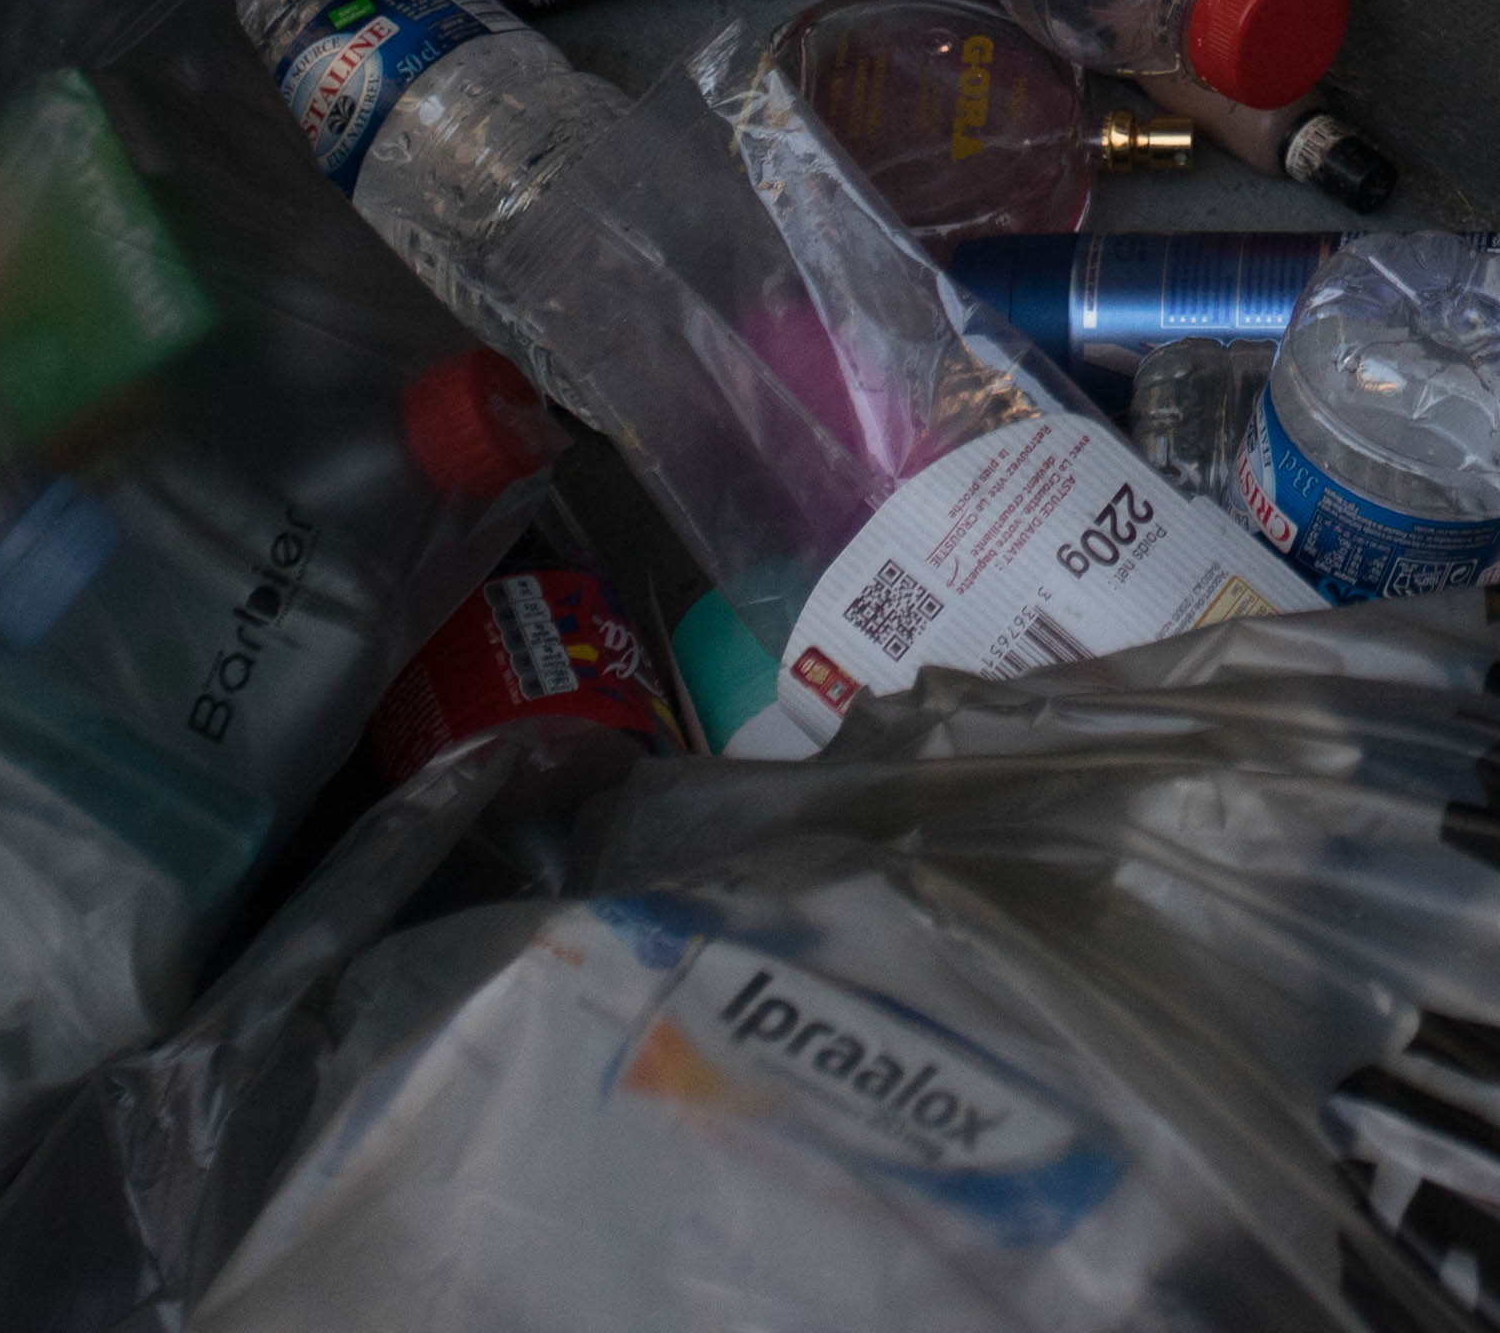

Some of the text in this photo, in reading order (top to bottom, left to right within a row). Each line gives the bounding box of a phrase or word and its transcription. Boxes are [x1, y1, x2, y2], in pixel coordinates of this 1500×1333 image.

[301, 22, 392, 139] STALINE
[1007, 425, 1052, 476] Retrouvez
[1070, 435, 1090, 459] avec
[949, 482, 980, 519] proche
[971, 454, 1056, 557] devient croustillante
[988, 477, 1007, 497] vite
[1040, 474, 1076, 518] ASTUCE
[1237, 455, 1290, 542] CRIST
[931, 513, 978, 569] CROUSTIE
[996, 517, 1023, 548] votre
[1056, 482, 1154, 579] 220g
[1130, 523, 1168, 563] Poids
[956, 549, 998, 595] baguette
[1036, 586, 1052, 602] 3
[189, 505, 314, 744] Barbier
[719, 970, 1008, 1155] Ipraalox
